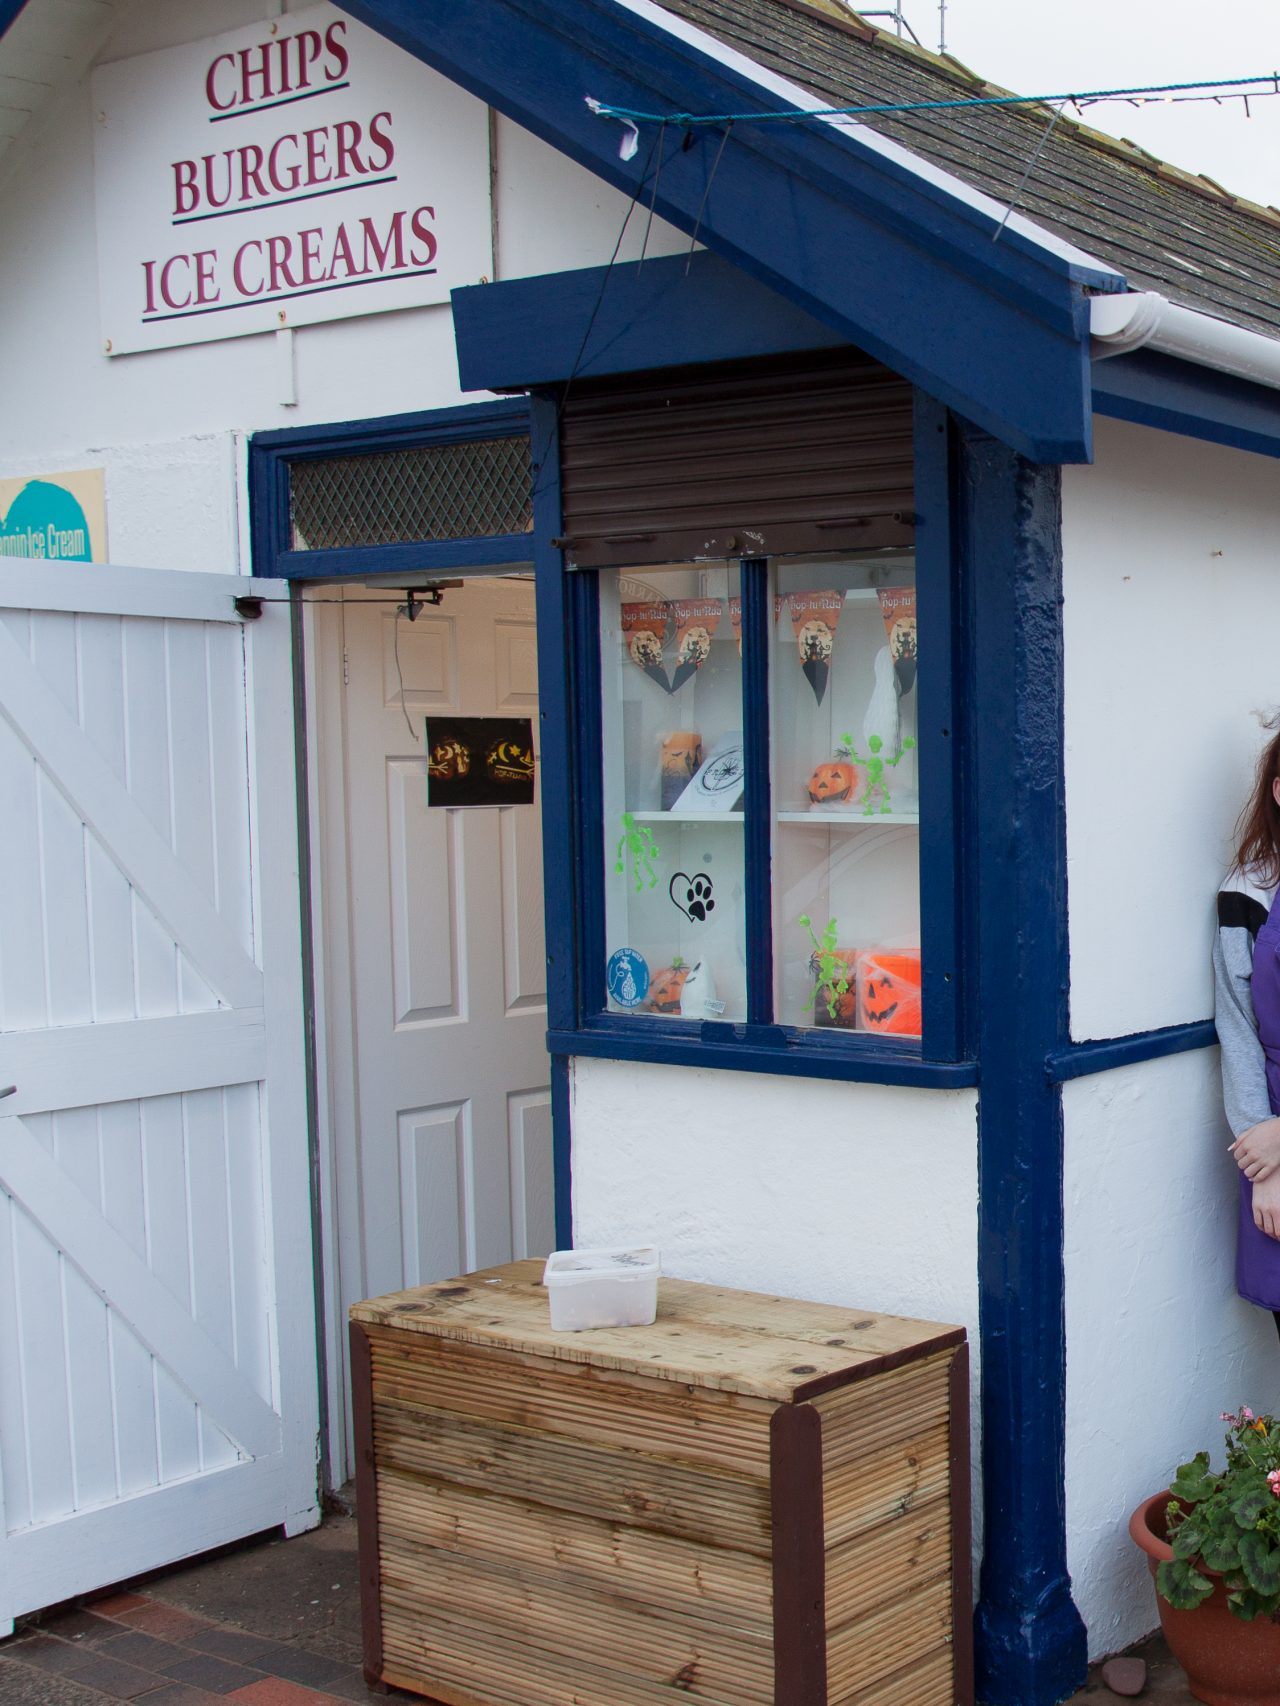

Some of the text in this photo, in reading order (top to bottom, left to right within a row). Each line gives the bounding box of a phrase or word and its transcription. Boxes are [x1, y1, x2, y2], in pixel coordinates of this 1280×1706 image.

[206, 20, 350, 111] CHIPS
[171, 111, 396, 216] BURGERS
[141, 206, 438, 314] ICE CREAMS
[47, 523, 85, 558] Cream
